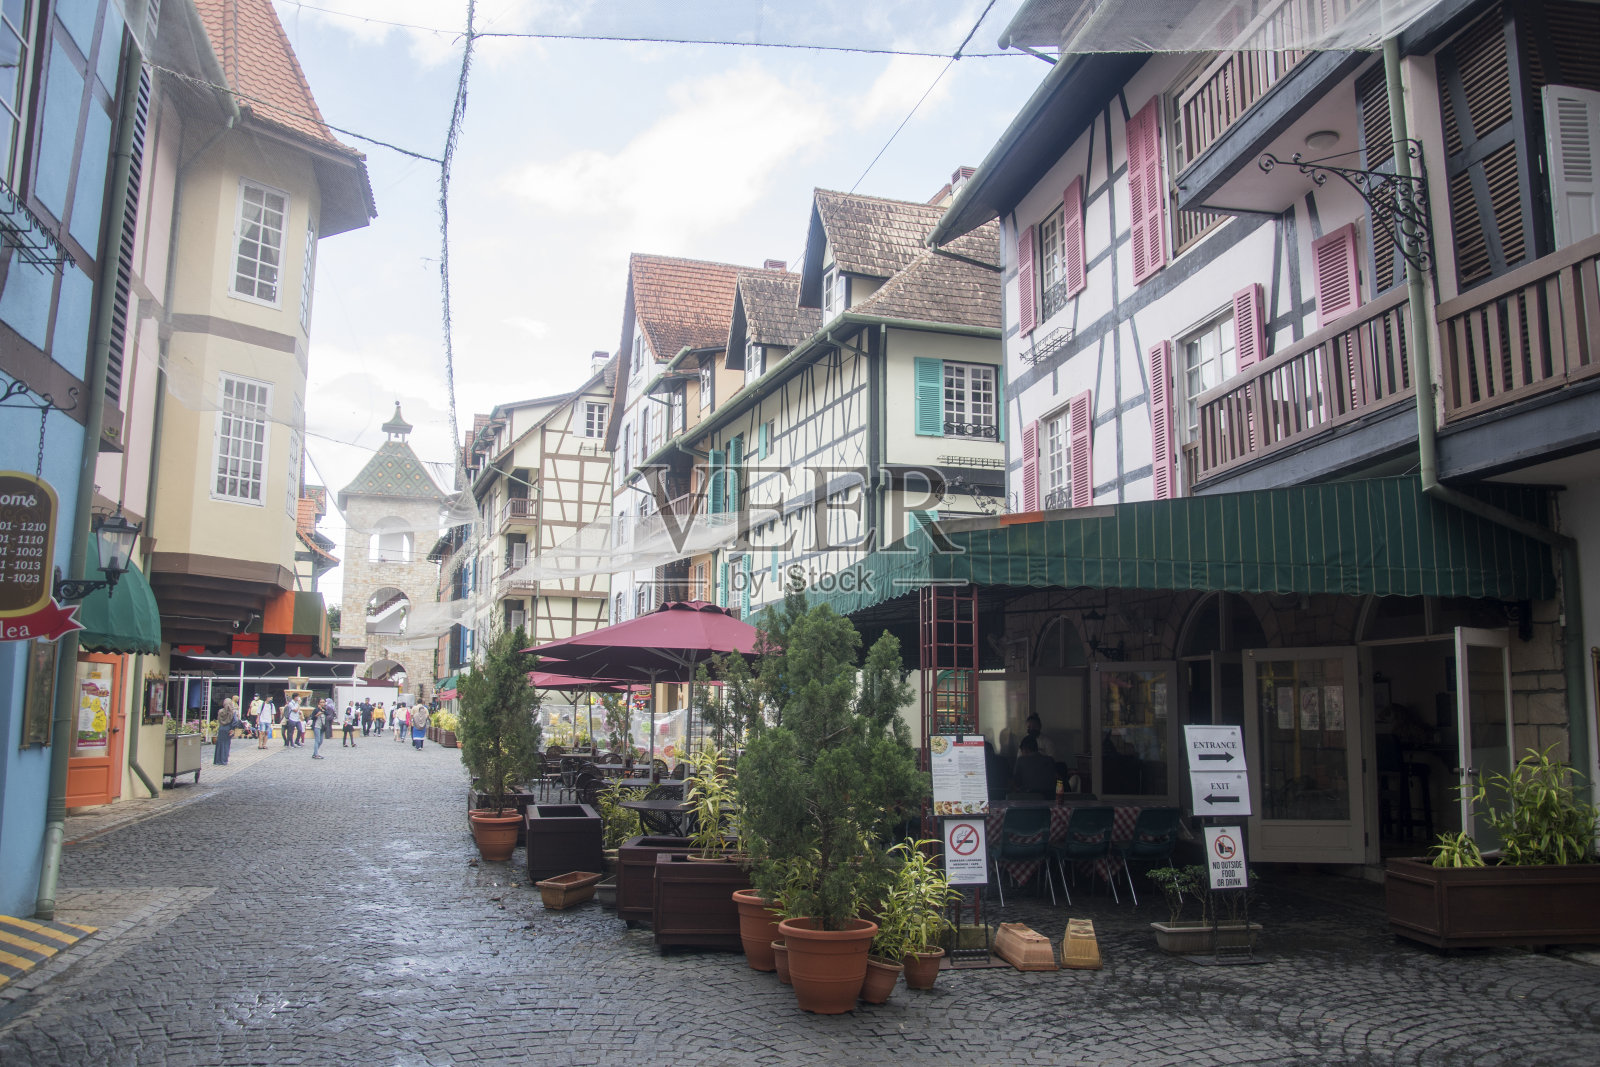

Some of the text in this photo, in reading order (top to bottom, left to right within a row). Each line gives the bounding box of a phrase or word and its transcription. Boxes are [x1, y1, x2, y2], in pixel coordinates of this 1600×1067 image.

[1193, 741, 1238, 750] ENTRANCE
[1210, 782, 1231, 790] EXIT
[1212, 861, 1243, 869] NO OUTSIDE
[1221, 869, 1236, 878] FOOD
[1217, 878, 1242, 887] OR DRINK
